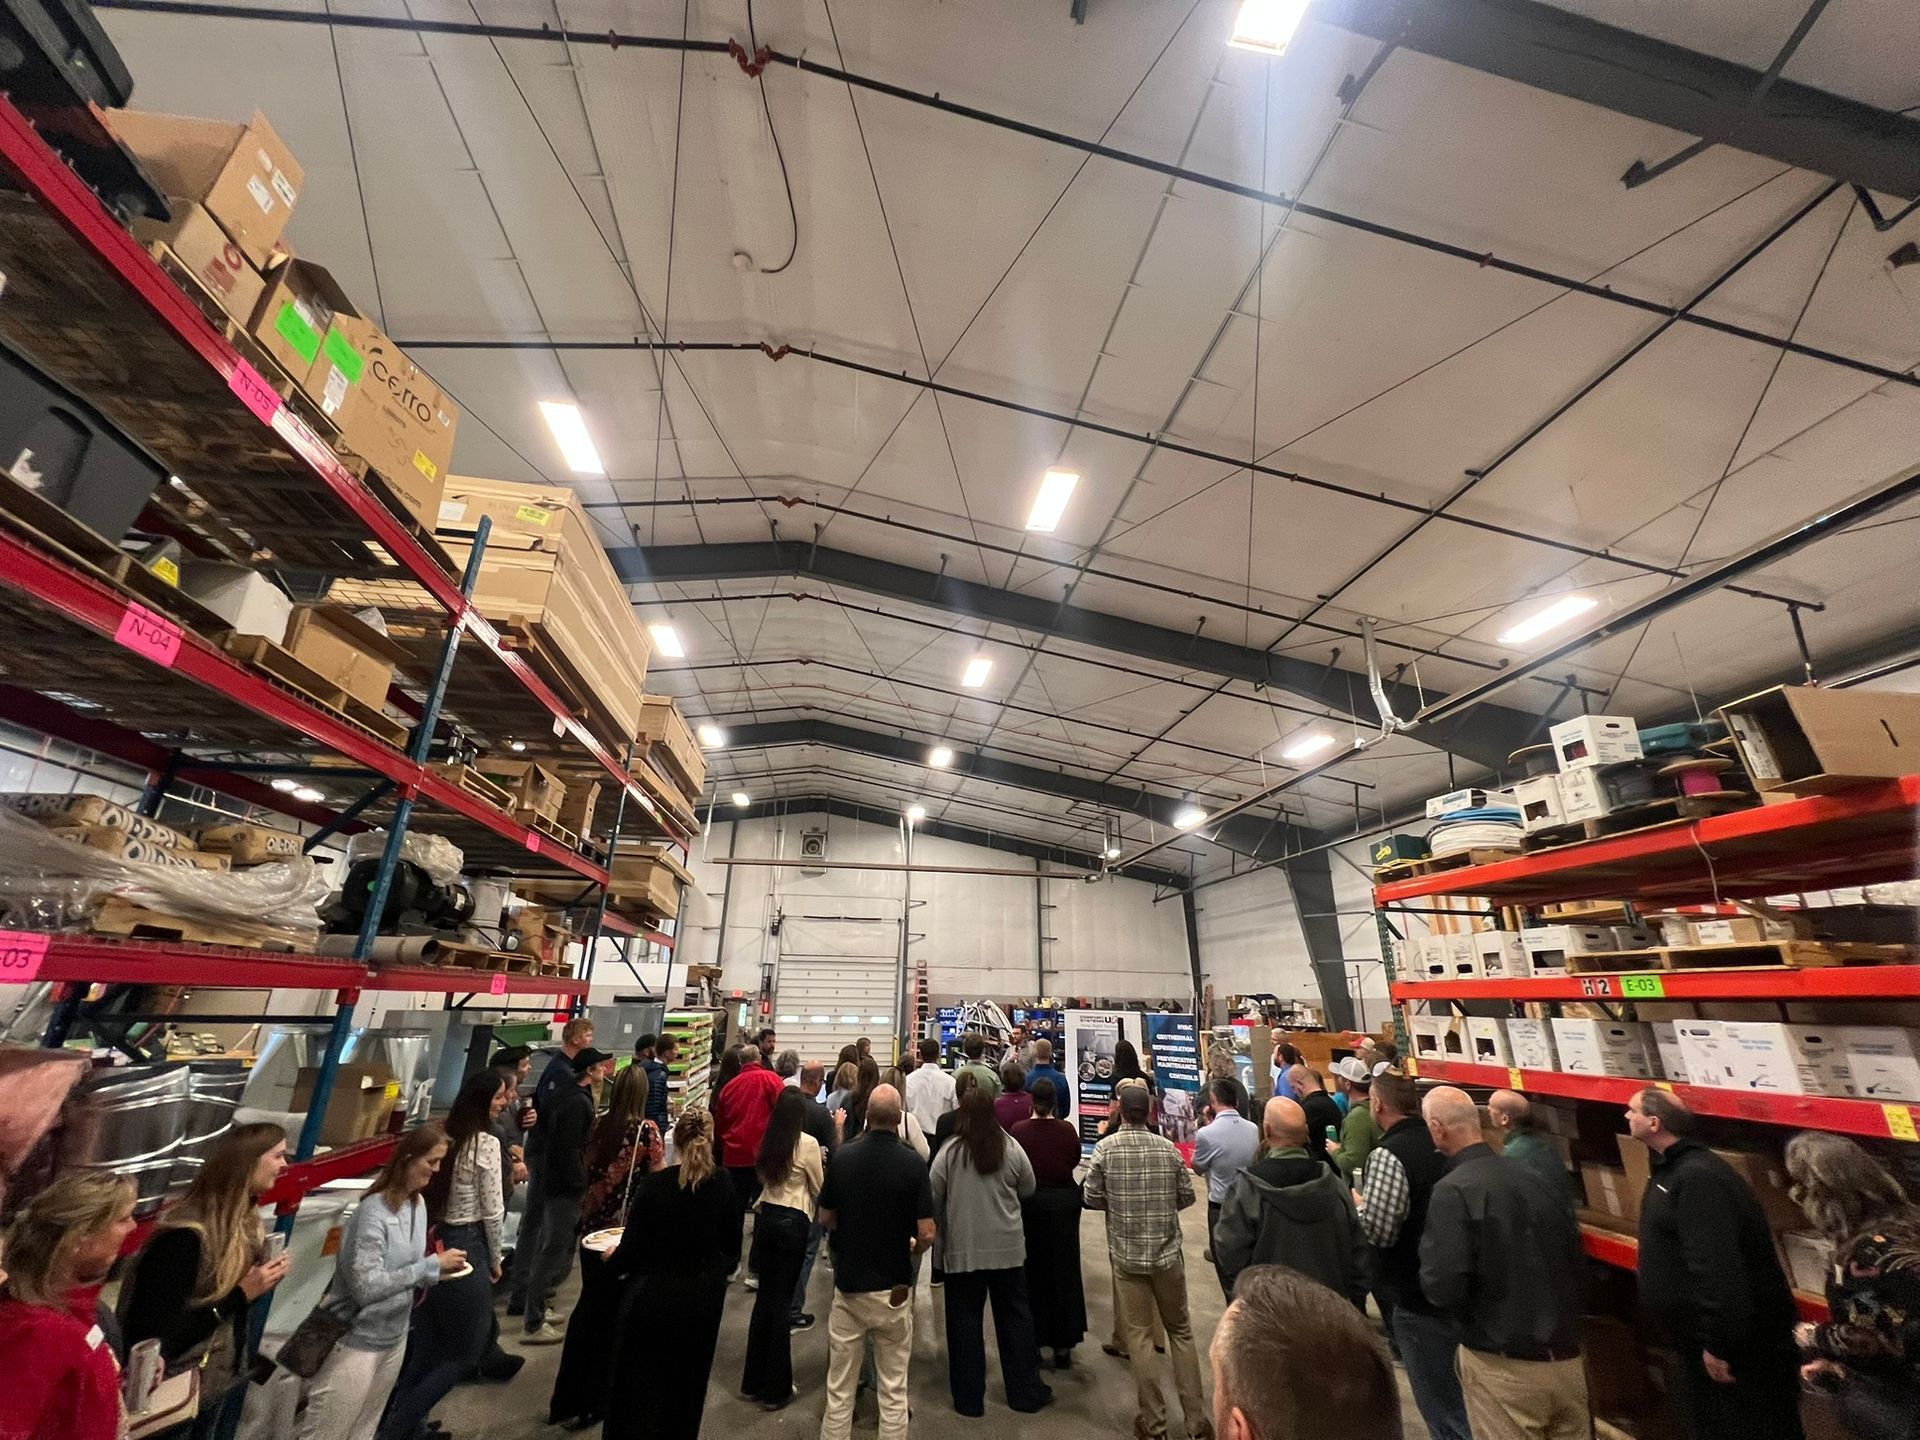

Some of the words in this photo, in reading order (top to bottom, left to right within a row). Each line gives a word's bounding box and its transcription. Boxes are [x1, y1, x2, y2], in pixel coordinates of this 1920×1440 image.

[372, 360, 432, 422] Cerro
[129, 618, 171, 650] N-04
[0, 948, 32, 969] 03
[1598, 979, 1610, 995] 2
[1626, 979, 1656, 992] E-03
